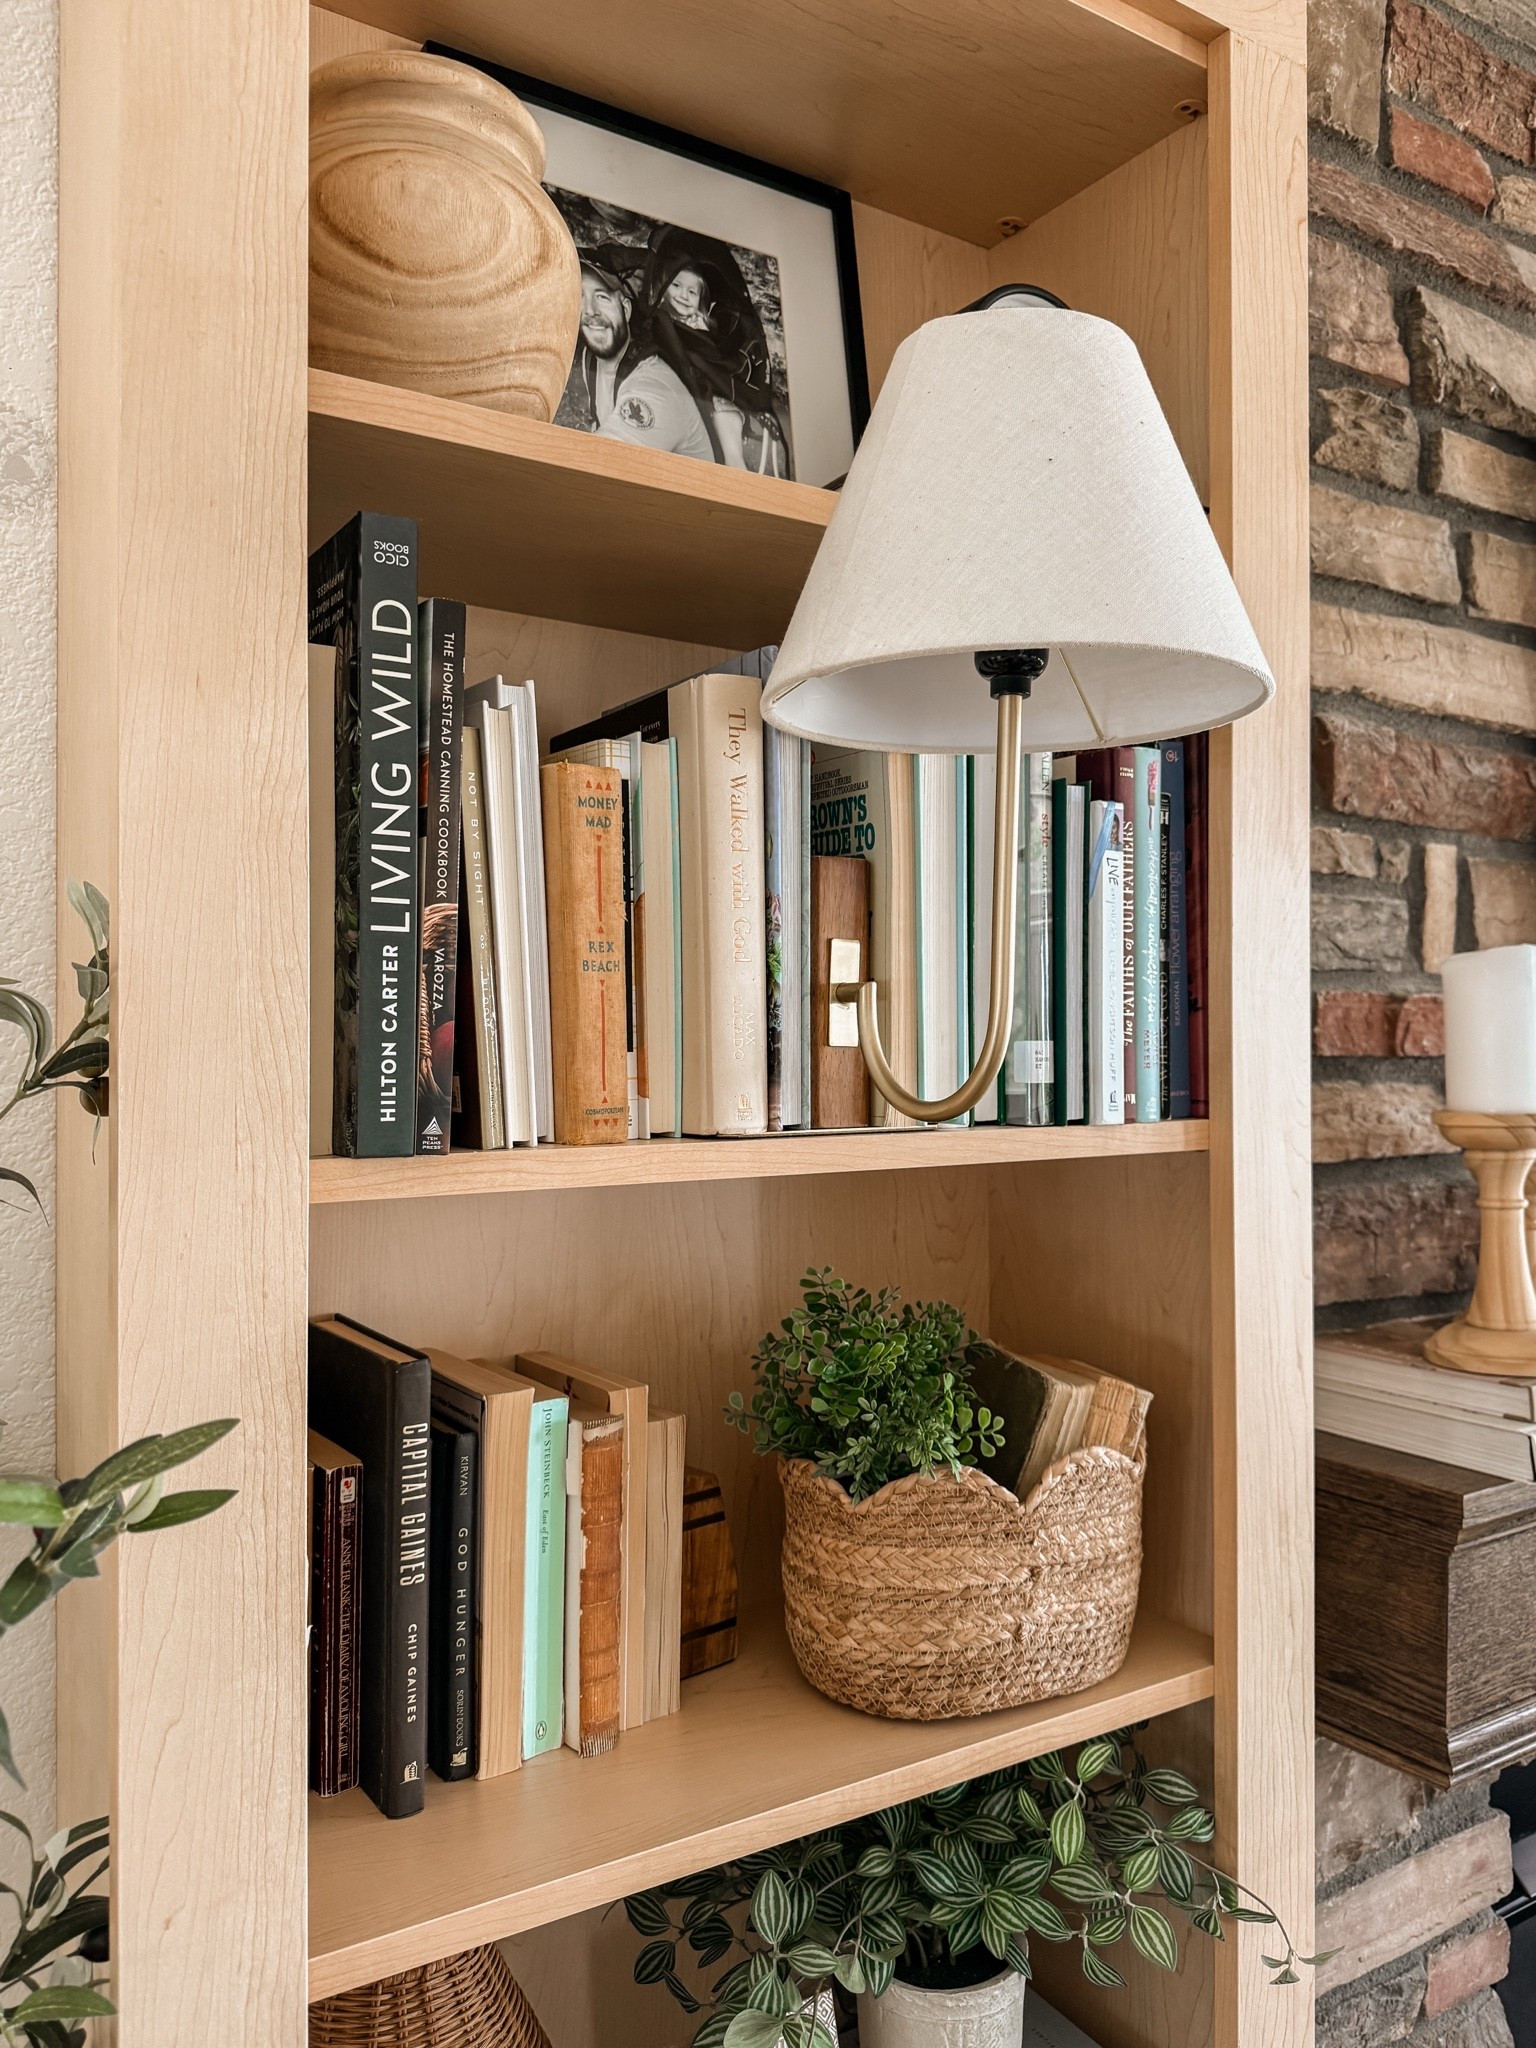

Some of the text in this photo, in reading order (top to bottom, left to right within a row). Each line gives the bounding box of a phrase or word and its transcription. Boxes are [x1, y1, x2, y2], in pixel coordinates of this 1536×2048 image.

[373, 540, 410, 554] BOOKS
[373, 551, 410, 567] CICO
[370, 599, 412, 934] LIVING WILD
[436, 632, 455, 898] THE HOMESTEAD CANNING COOKBOOK
[1041, 752, 1050, 791] ALLEN
[578, 795, 618, 811] MONEY
[585, 815, 612, 829] MAD
[468, 771, 484, 906] NOT BY SIGHT
[723, 707, 752, 963] They Walked with God
[854, 822, 876, 852] TO
[1040, 813, 1052, 848] style
[1106, 857, 1119, 886] LIVE
[1123, 821, 1134, 895] FATHERS
[1160, 834, 1168, 877] STANLEY
[1169, 850, 1181, 924] arranging
[1123, 899, 1134, 933] OUR
[582, 960, 621, 973] BEACH
[589, 941, 615, 953] REX
[1170, 927, 1180, 975] flower
[432, 948, 445, 1011] VAROZZA
[1123, 955, 1134, 1017] FAITHS
[380, 944, 399, 1122] HILTON CARTER
[732, 994, 745, 1061] LUCADO
[745, 1011, 755, 1045] MAX
[1143, 1030, 1151, 1069] MEYER
[543, 1408, 552, 1498] JOHN STEINBECK
[459, 1455, 469, 1496] KIRVAN
[400, 1422, 428, 1587] CAPITAL GAINES
[541, 1526, 549, 1534] of
[541, 1536, 549, 1554] Eden
[455, 1527, 468, 1676] GOD HUNGER
[407, 1623, 417, 1723] CHIP GAINES
[455, 1689, 464, 1716] SORIN
